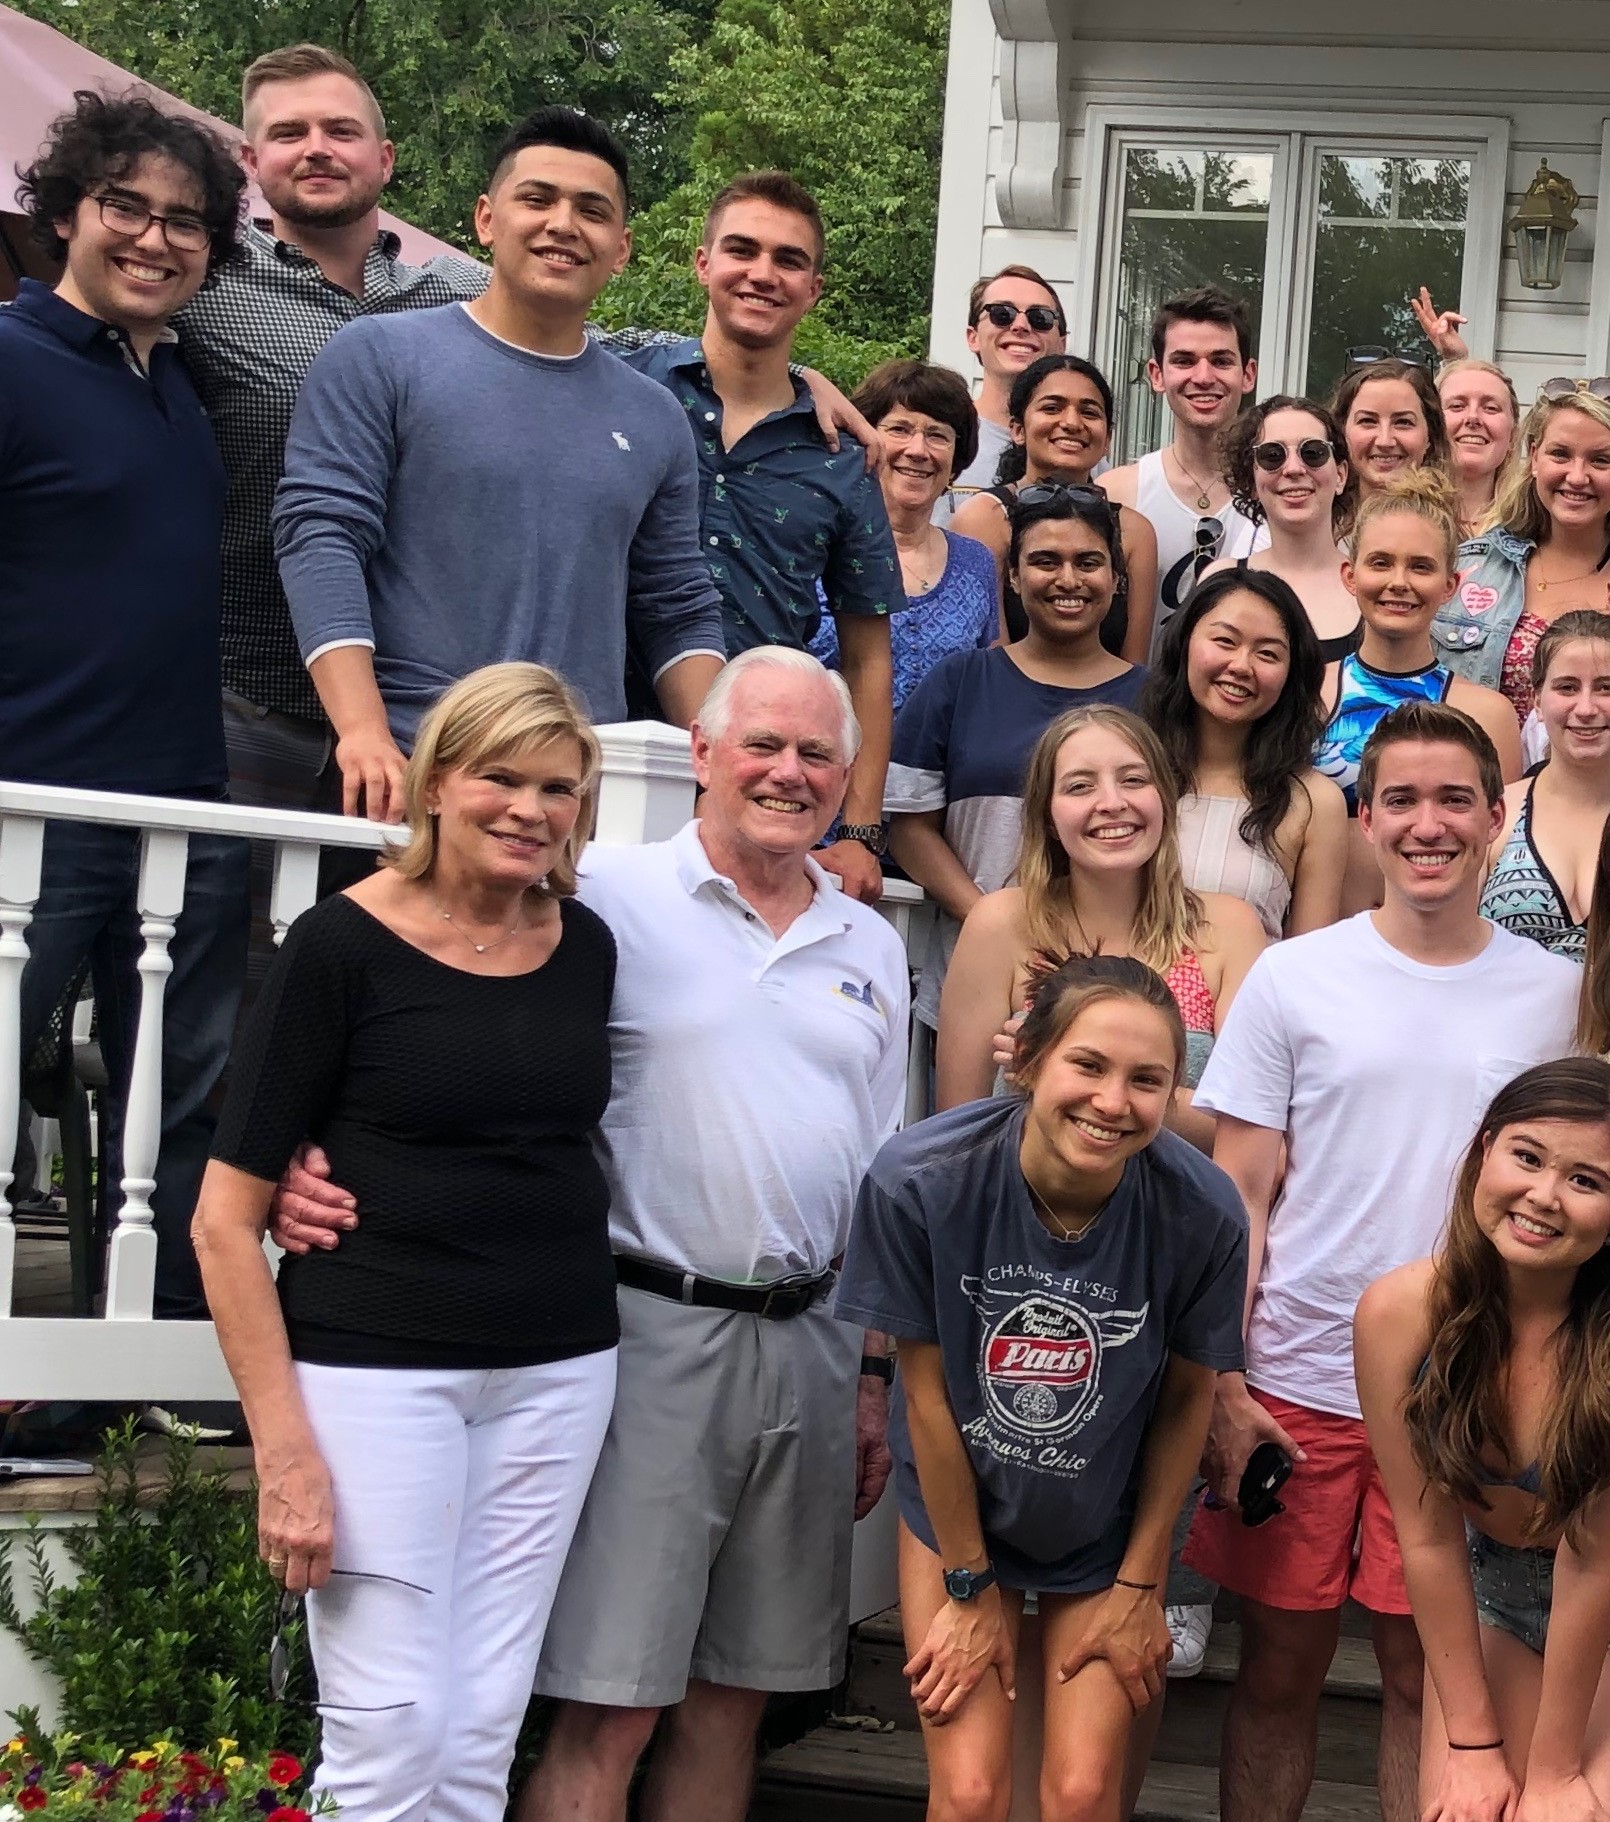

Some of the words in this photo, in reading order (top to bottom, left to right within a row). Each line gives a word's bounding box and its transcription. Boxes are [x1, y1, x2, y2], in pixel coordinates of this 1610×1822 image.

[1020, 1306, 1065, 1326] Produit
[997, 1342, 1090, 1371] Paris
[1037, 1446, 1092, 1470] Chic
